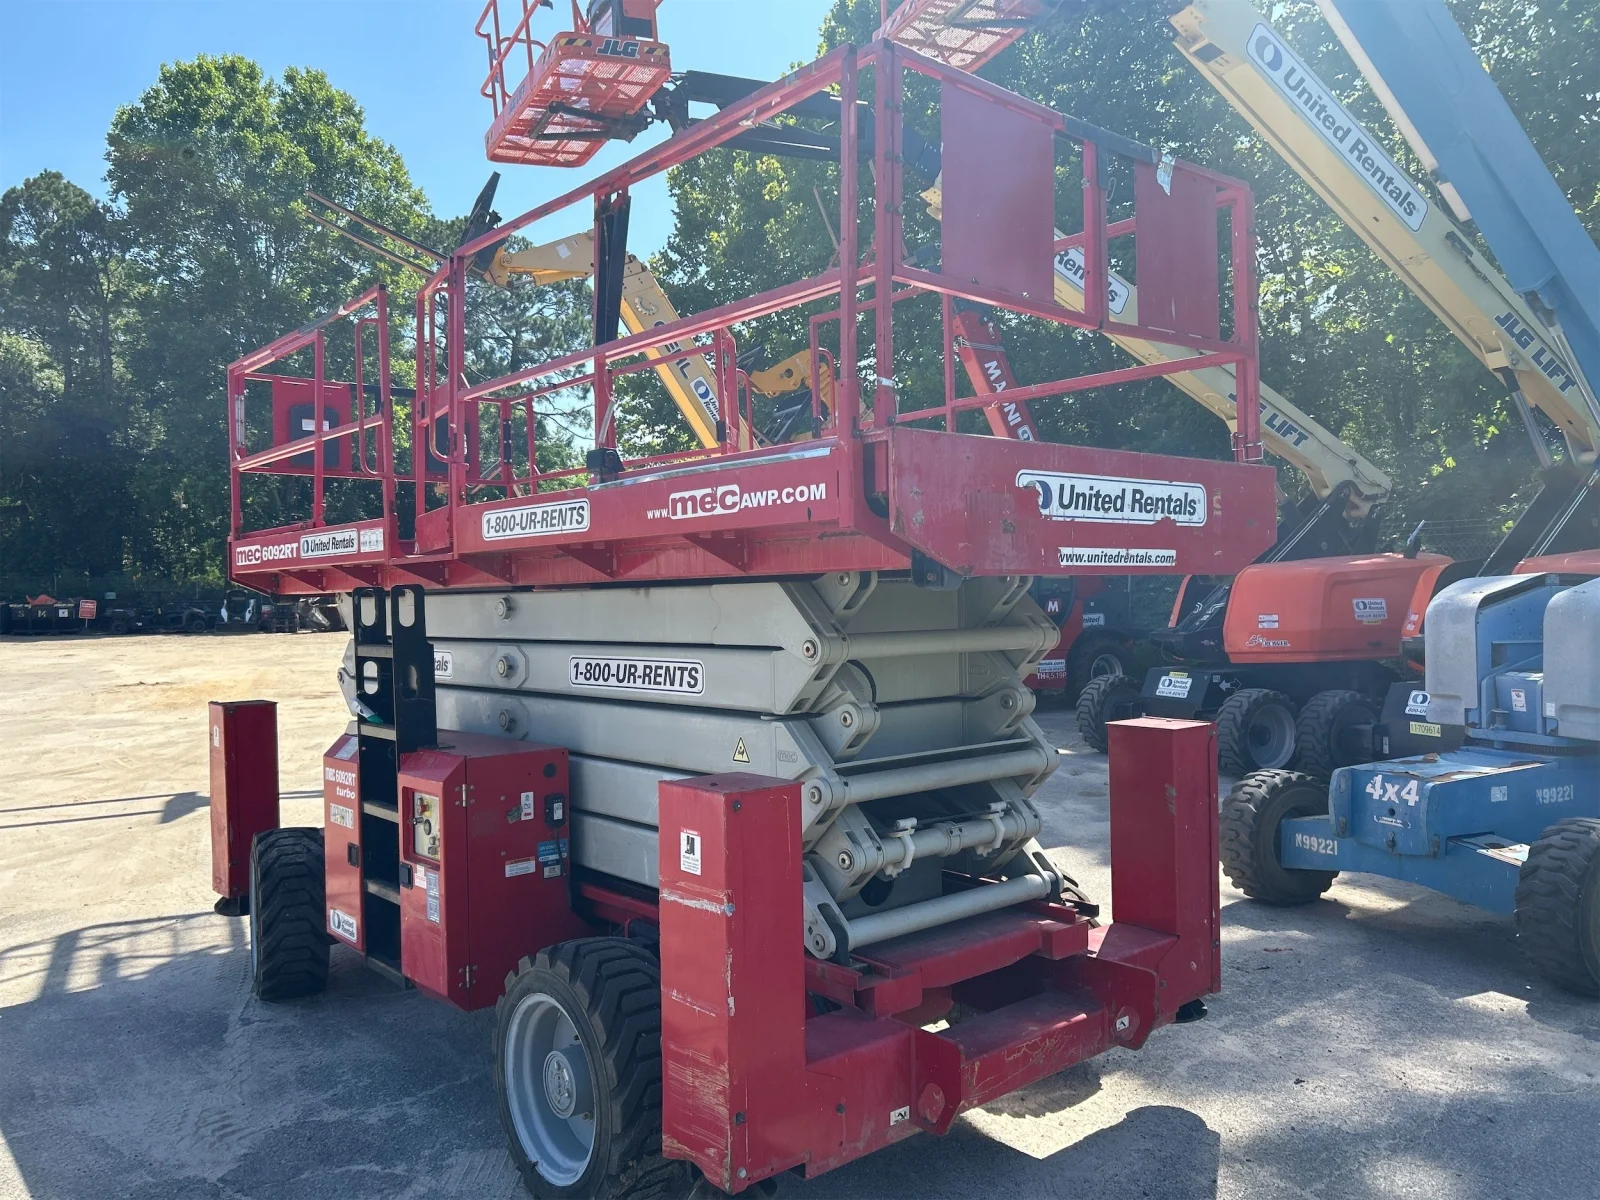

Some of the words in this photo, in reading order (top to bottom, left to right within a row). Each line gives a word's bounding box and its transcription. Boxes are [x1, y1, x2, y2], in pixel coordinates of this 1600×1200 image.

[597, 39, 640, 58] JLG
[1283, 66, 1352, 145] United
[1349, 137, 1417, 218] Rentals
[1494, 311, 1536, 350] JLG
[1531, 346, 1577, 393] LIFT
[984, 361, 1022, 426] MANI
[1264, 412, 1309, 447] LIFT
[1058, 484, 1126, 513] United
[1130, 488, 1197, 516] Rentals
[485, 504, 586, 534] 1-800-UR-RENTS
[262, 543, 298, 561] 6092RT
[310, 538, 330, 553] United
[331, 535, 355, 551] Rentals
[1058, 550, 1175, 564] www.unitedrentals.com
[1047, 601, 1059, 612] M
[572, 661, 699, 689] 1-800-UR-RENTS
[336, 770, 356, 787] 6092RT
[1365, 774, 1419, 806] 4x4
[336, 786, 356, 799] turbo
[1295, 833, 1338, 855] N99221
